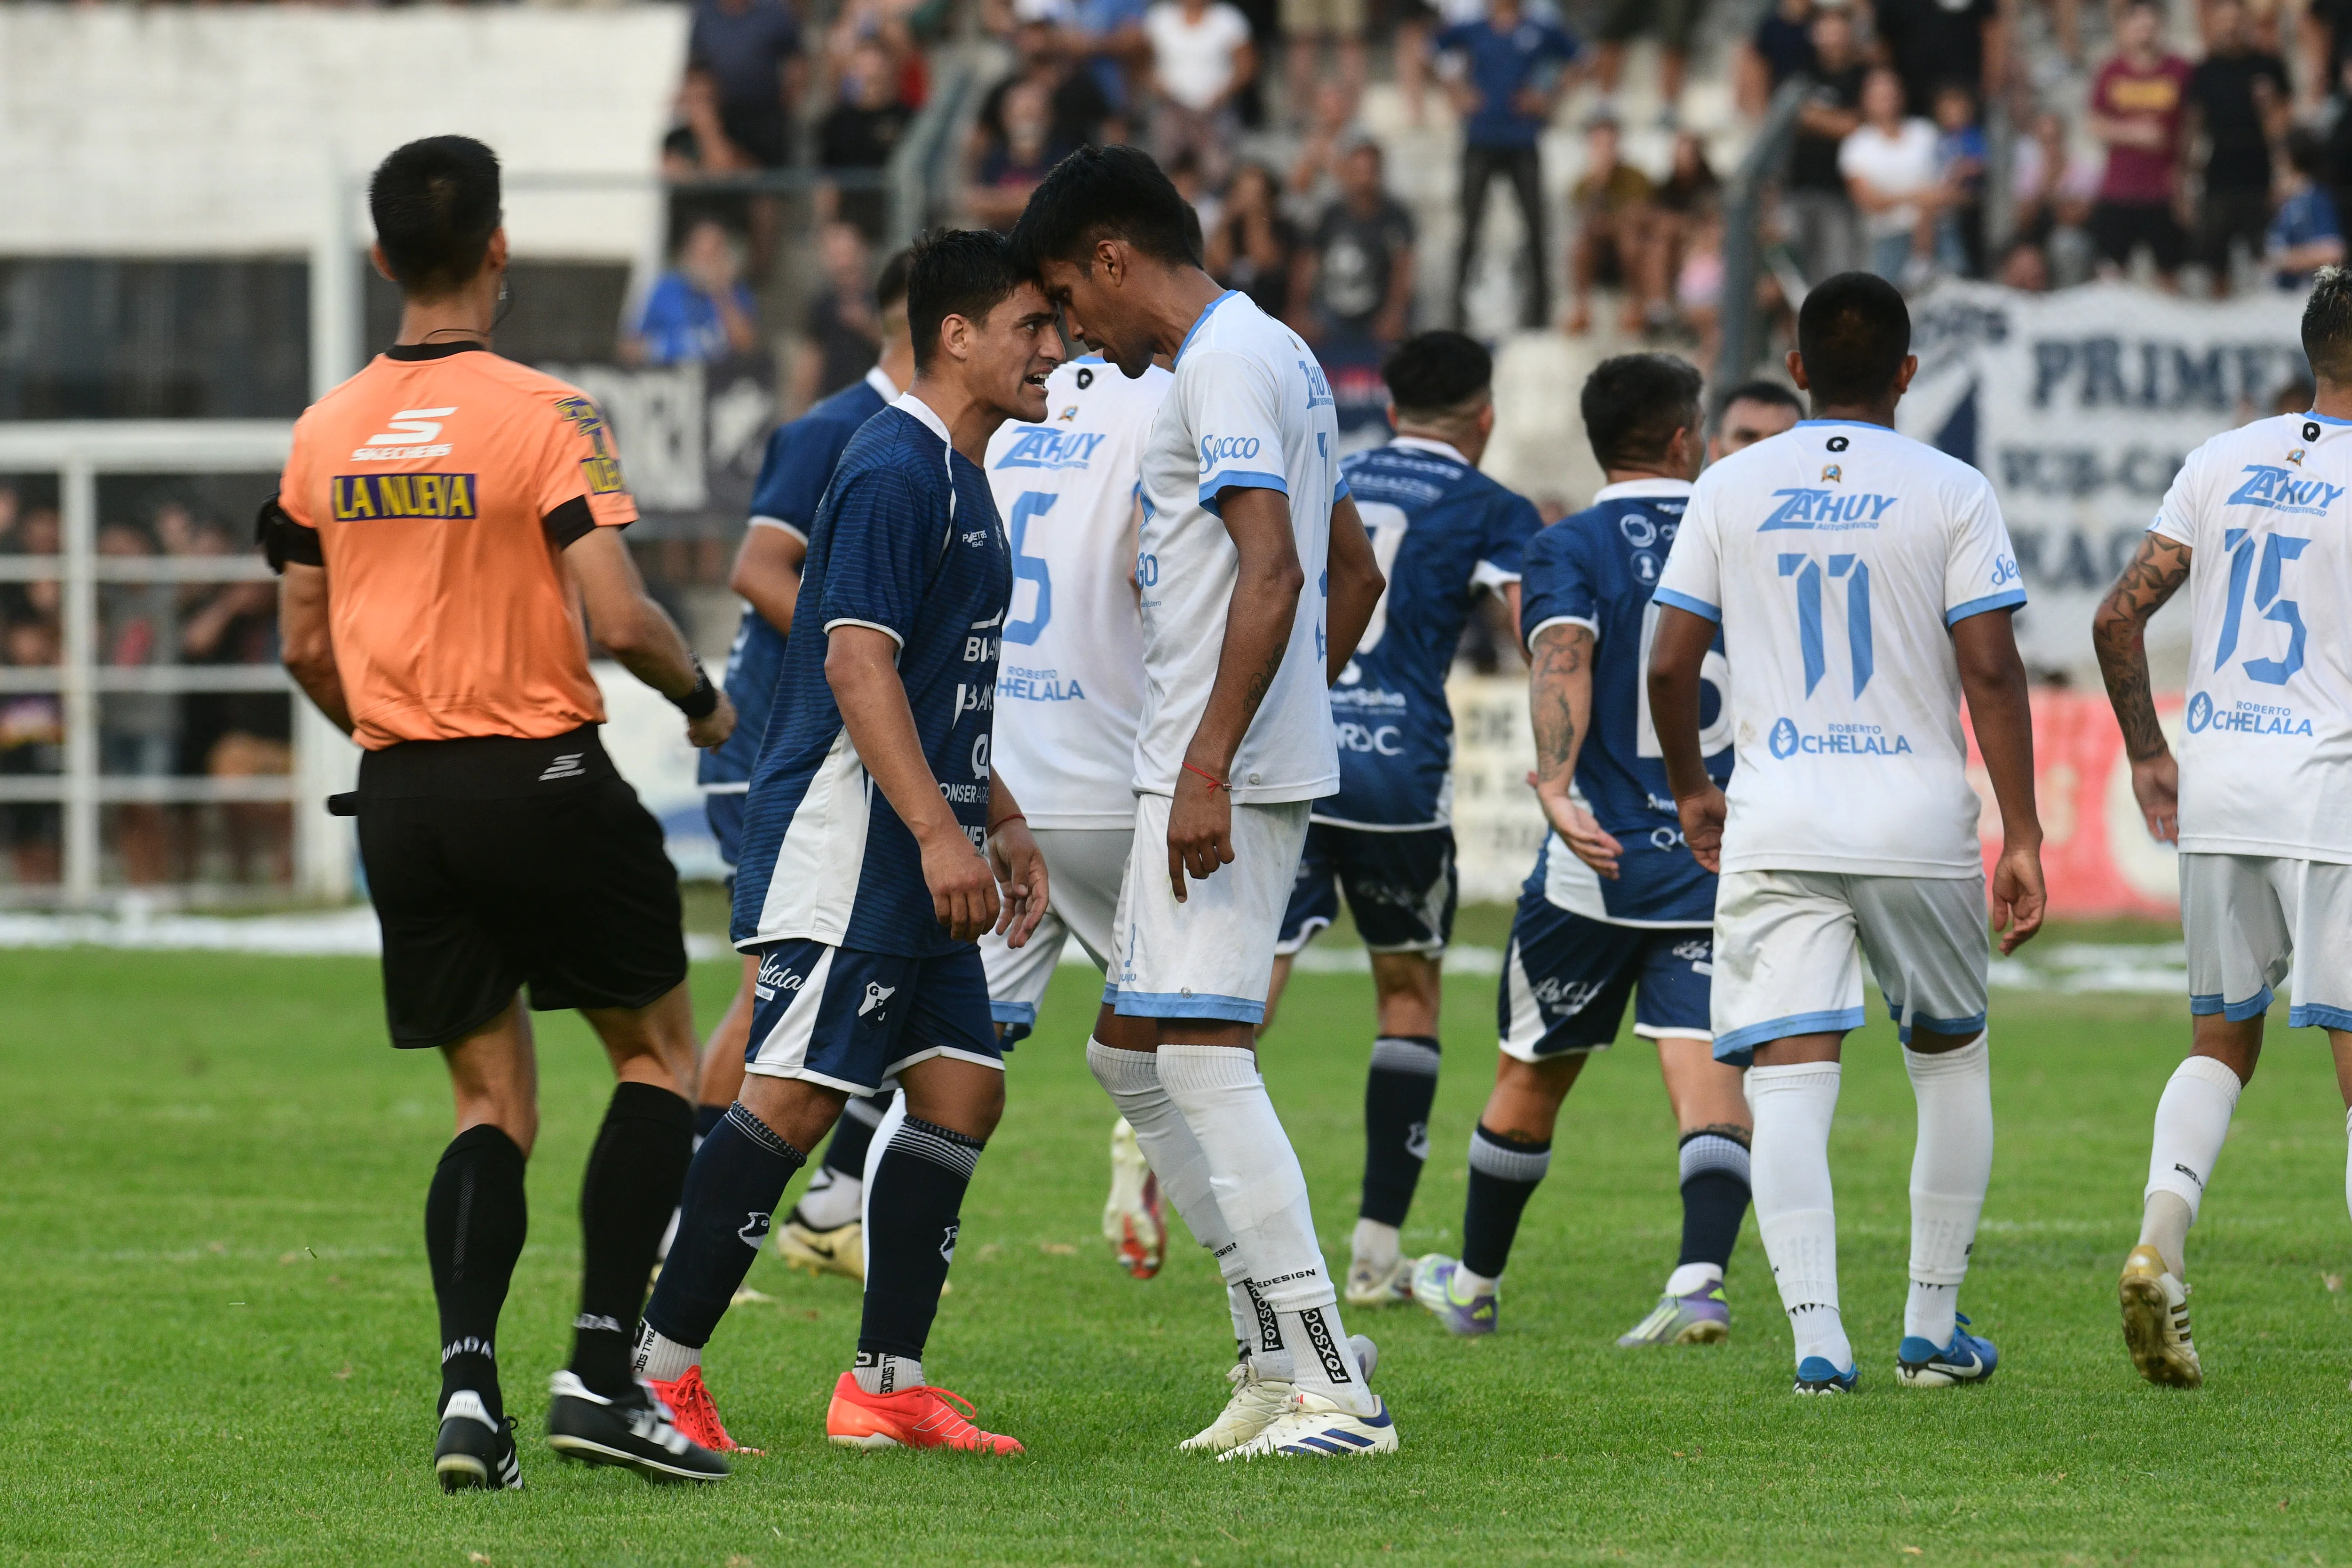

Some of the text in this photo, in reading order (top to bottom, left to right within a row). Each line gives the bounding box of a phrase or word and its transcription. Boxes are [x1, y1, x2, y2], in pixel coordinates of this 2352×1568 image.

[350, 443, 454, 461] SKECHERS
[1199, 434, 1260, 474] Secco
[334, 475, 474, 518] LA NUEVA
[2224, 464, 2346, 509] ZAHUY
[1756, 488, 1898, 532] ZAHUY
[1135, 552, 1158, 590] GO
[2214, 528, 2312, 685] 15
[1778, 553, 1873, 702] 11
[995, 677, 1086, 701] HELALA
[2212, 710, 2313, 737] CHELALA
[2236, 700, 2291, 716] ROBERTO
[1828, 723, 1881, 734] ROBERTO
[1801, 734, 1913, 756] CHELALA
[1254, 1269, 1316, 1289] EDESIGN
[883, 1353, 896, 1367] LL
[1303, 1309, 1349, 1381] FOXSOC
